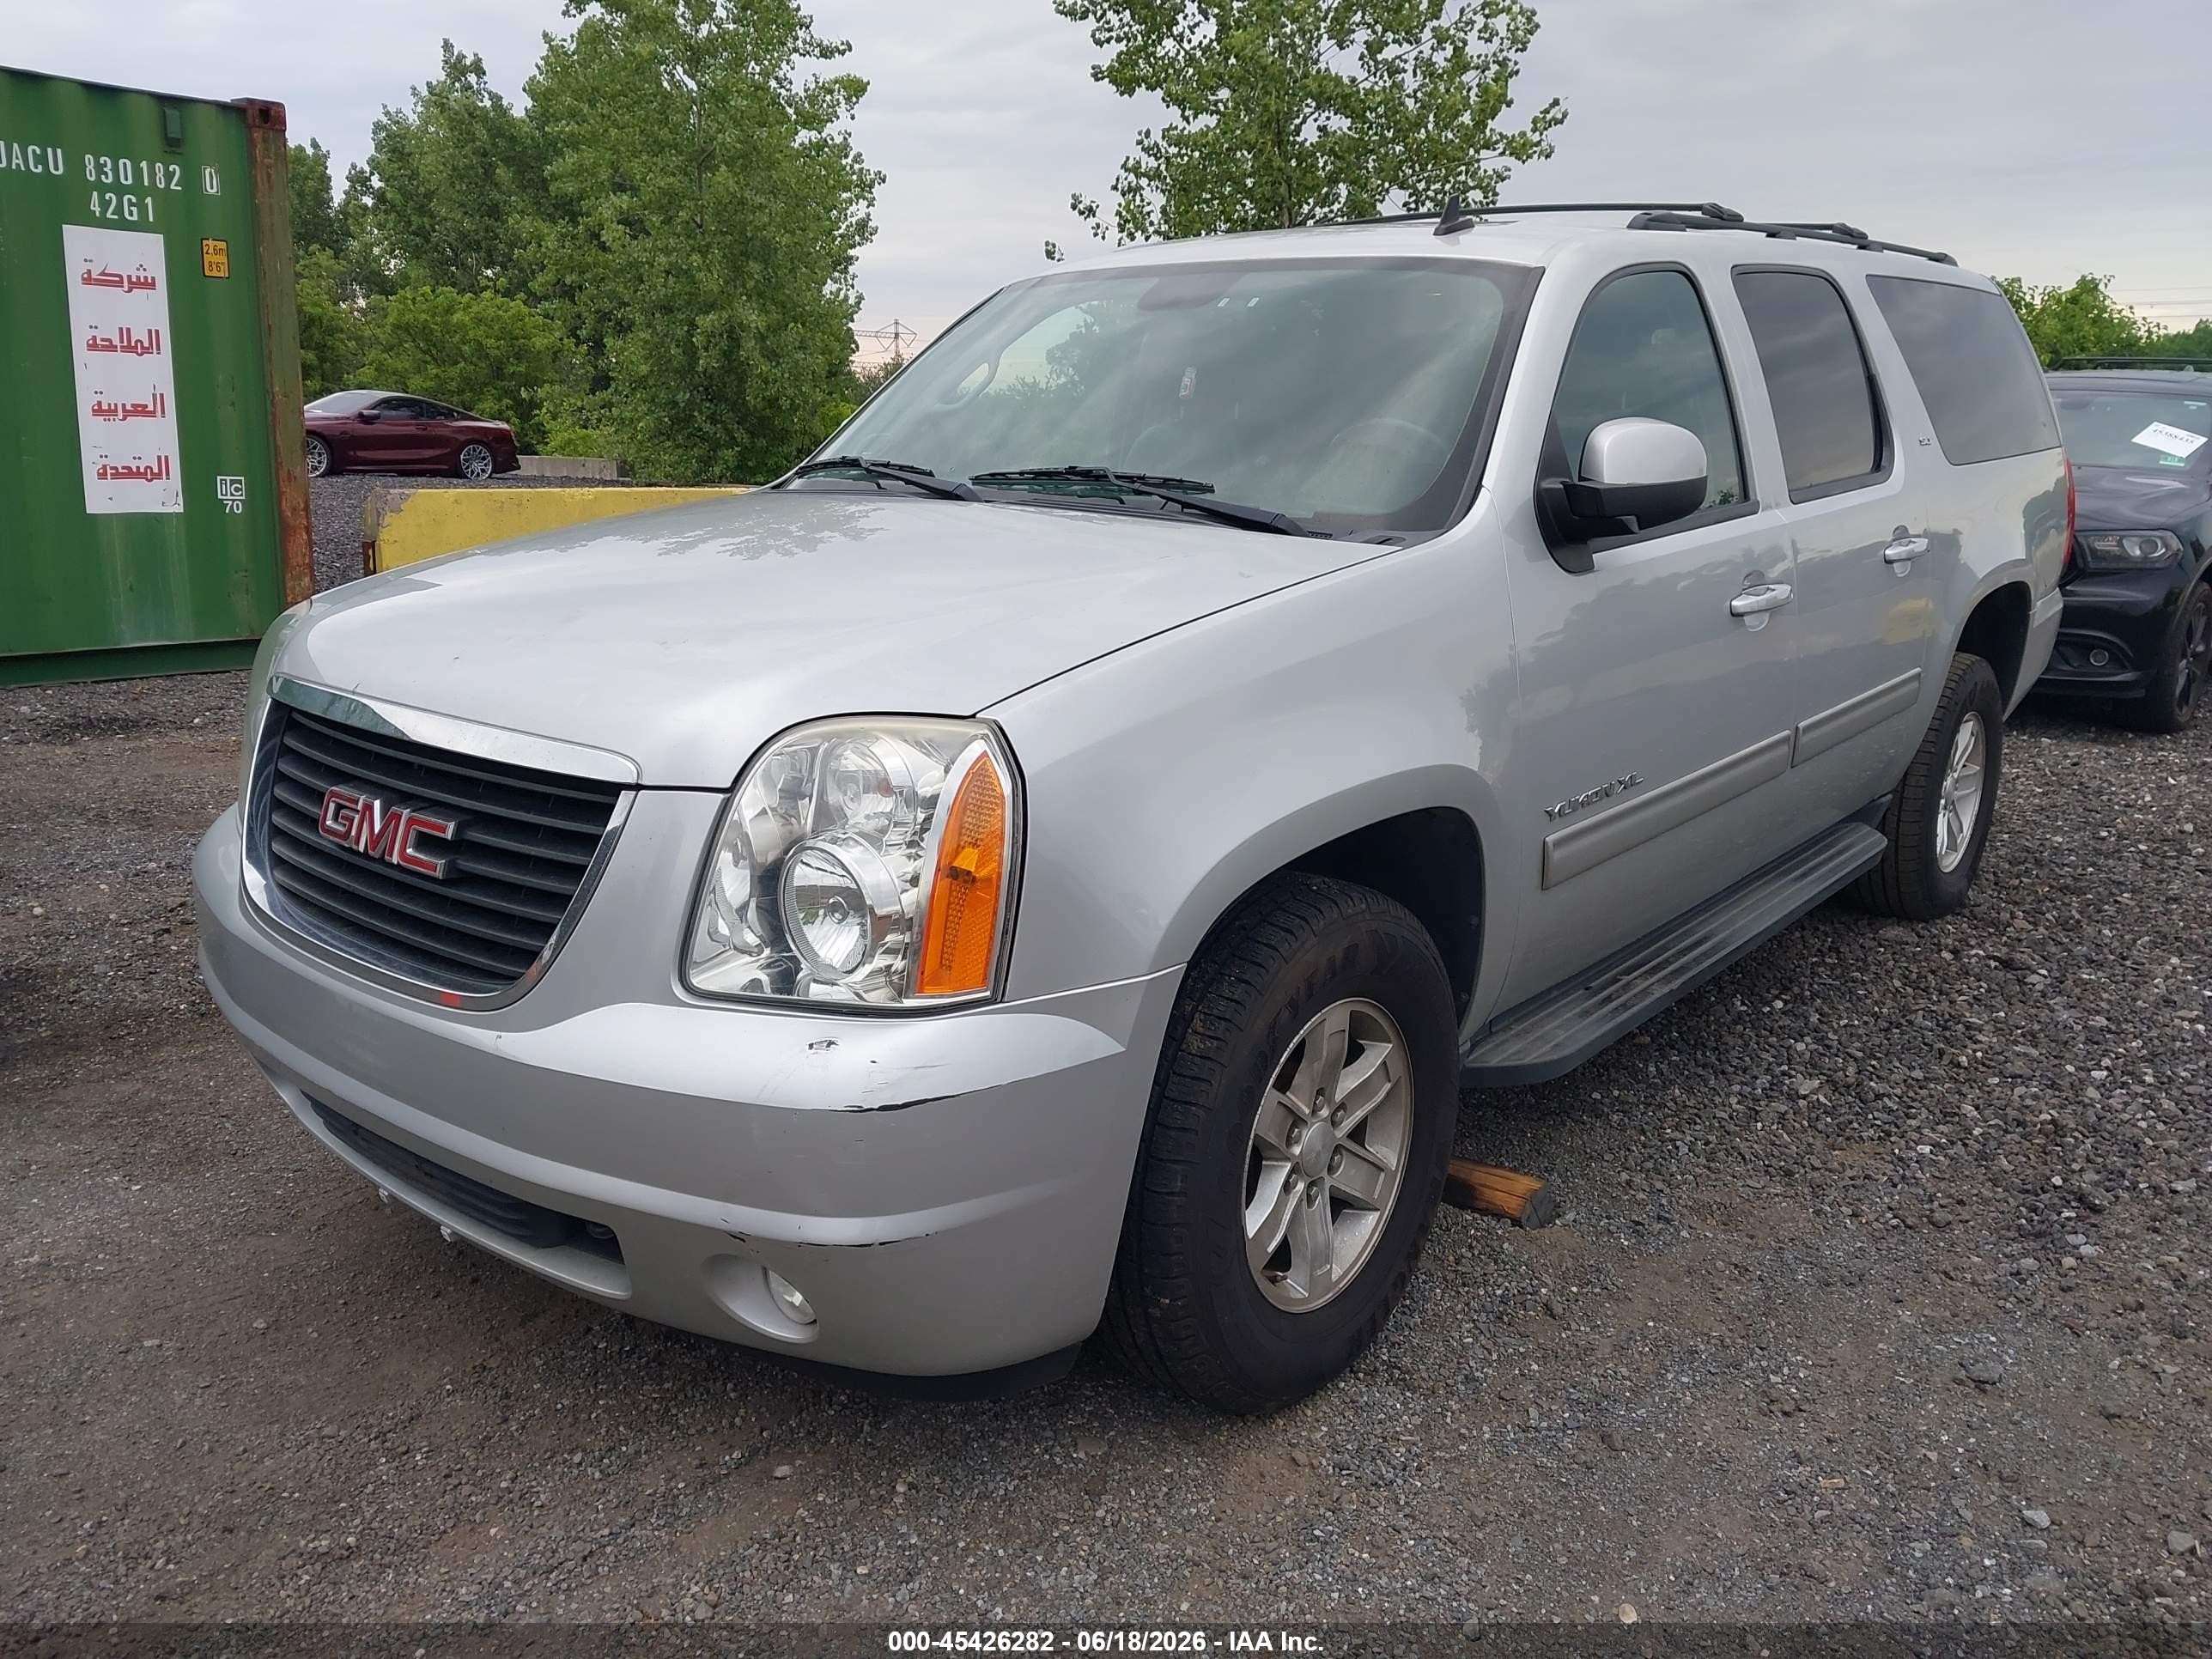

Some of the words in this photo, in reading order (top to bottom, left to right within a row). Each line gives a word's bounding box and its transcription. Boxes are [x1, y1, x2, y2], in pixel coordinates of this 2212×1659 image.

[85, 154, 182, 190] 830182
[90, 191, 154, 222] 42G1
[81, 258, 157, 294] شركة
[87, 325, 161, 356] الملاحة
[91, 390, 166, 422] العربية
[96, 454, 171, 483] المتحدة
[223, 500, 242, 514] 70
[319, 785, 457, 881] GMC
